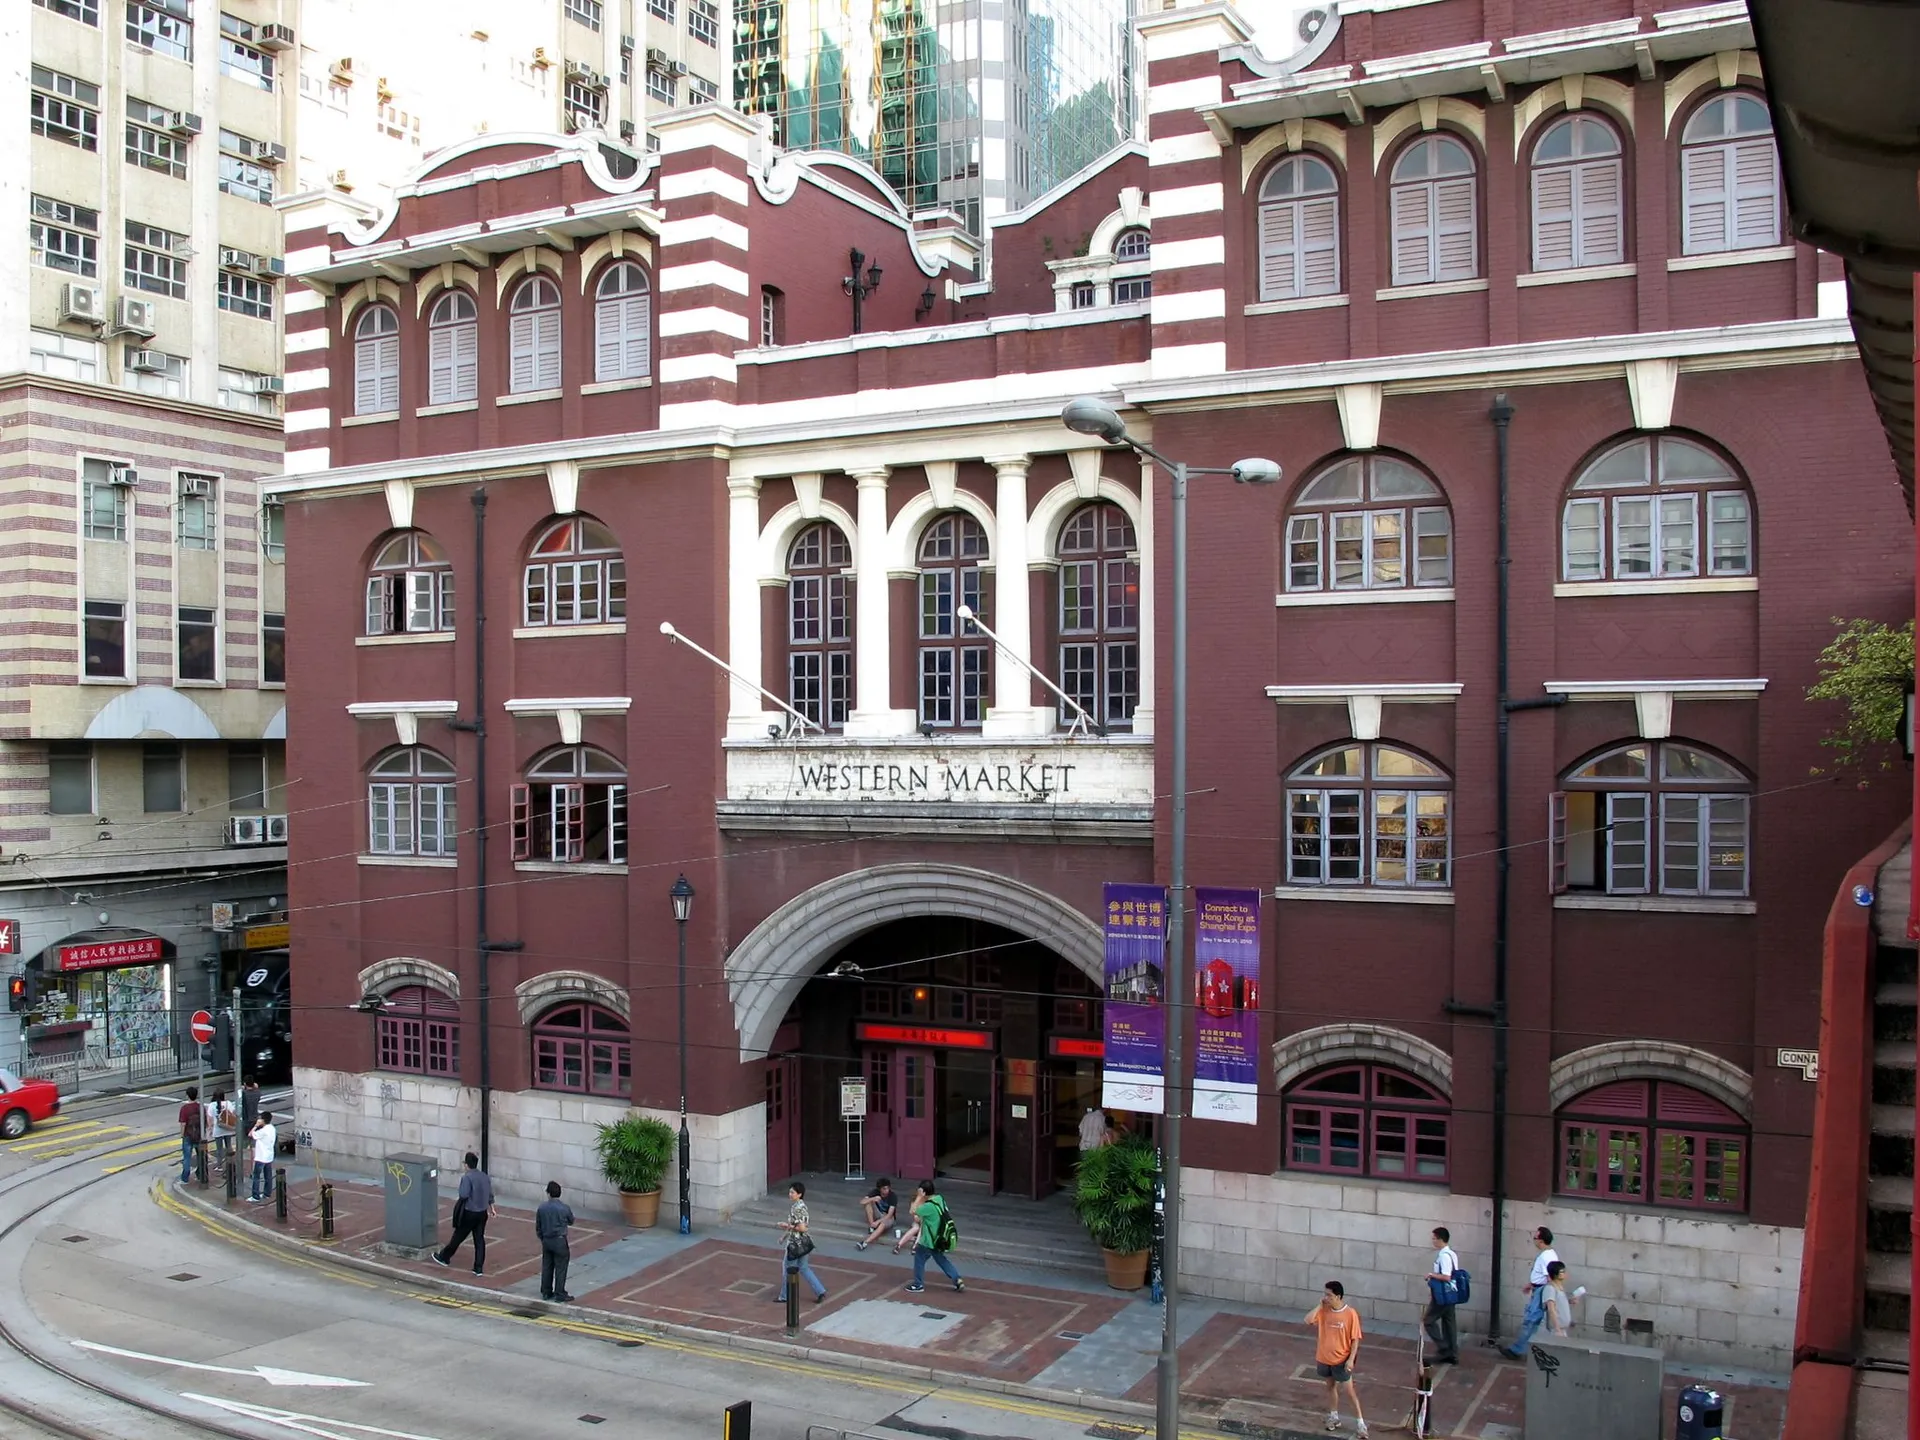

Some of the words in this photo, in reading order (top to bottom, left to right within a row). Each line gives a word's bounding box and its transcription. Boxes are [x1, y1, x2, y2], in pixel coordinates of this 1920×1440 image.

[798, 764, 928, 791] WESTERN
[943, 764, 1076, 792] MARKET
[1205, 904, 1239, 912] Connect
[1239, 905, 1248, 913] to
[1201, 912, 1222, 923] Hong
[1224, 913, 1244, 924] Kong
[1246, 915, 1256, 923] at
[1199, 921, 1236, 932] Shanghai
[1237, 923, 1256, 933] Expo
